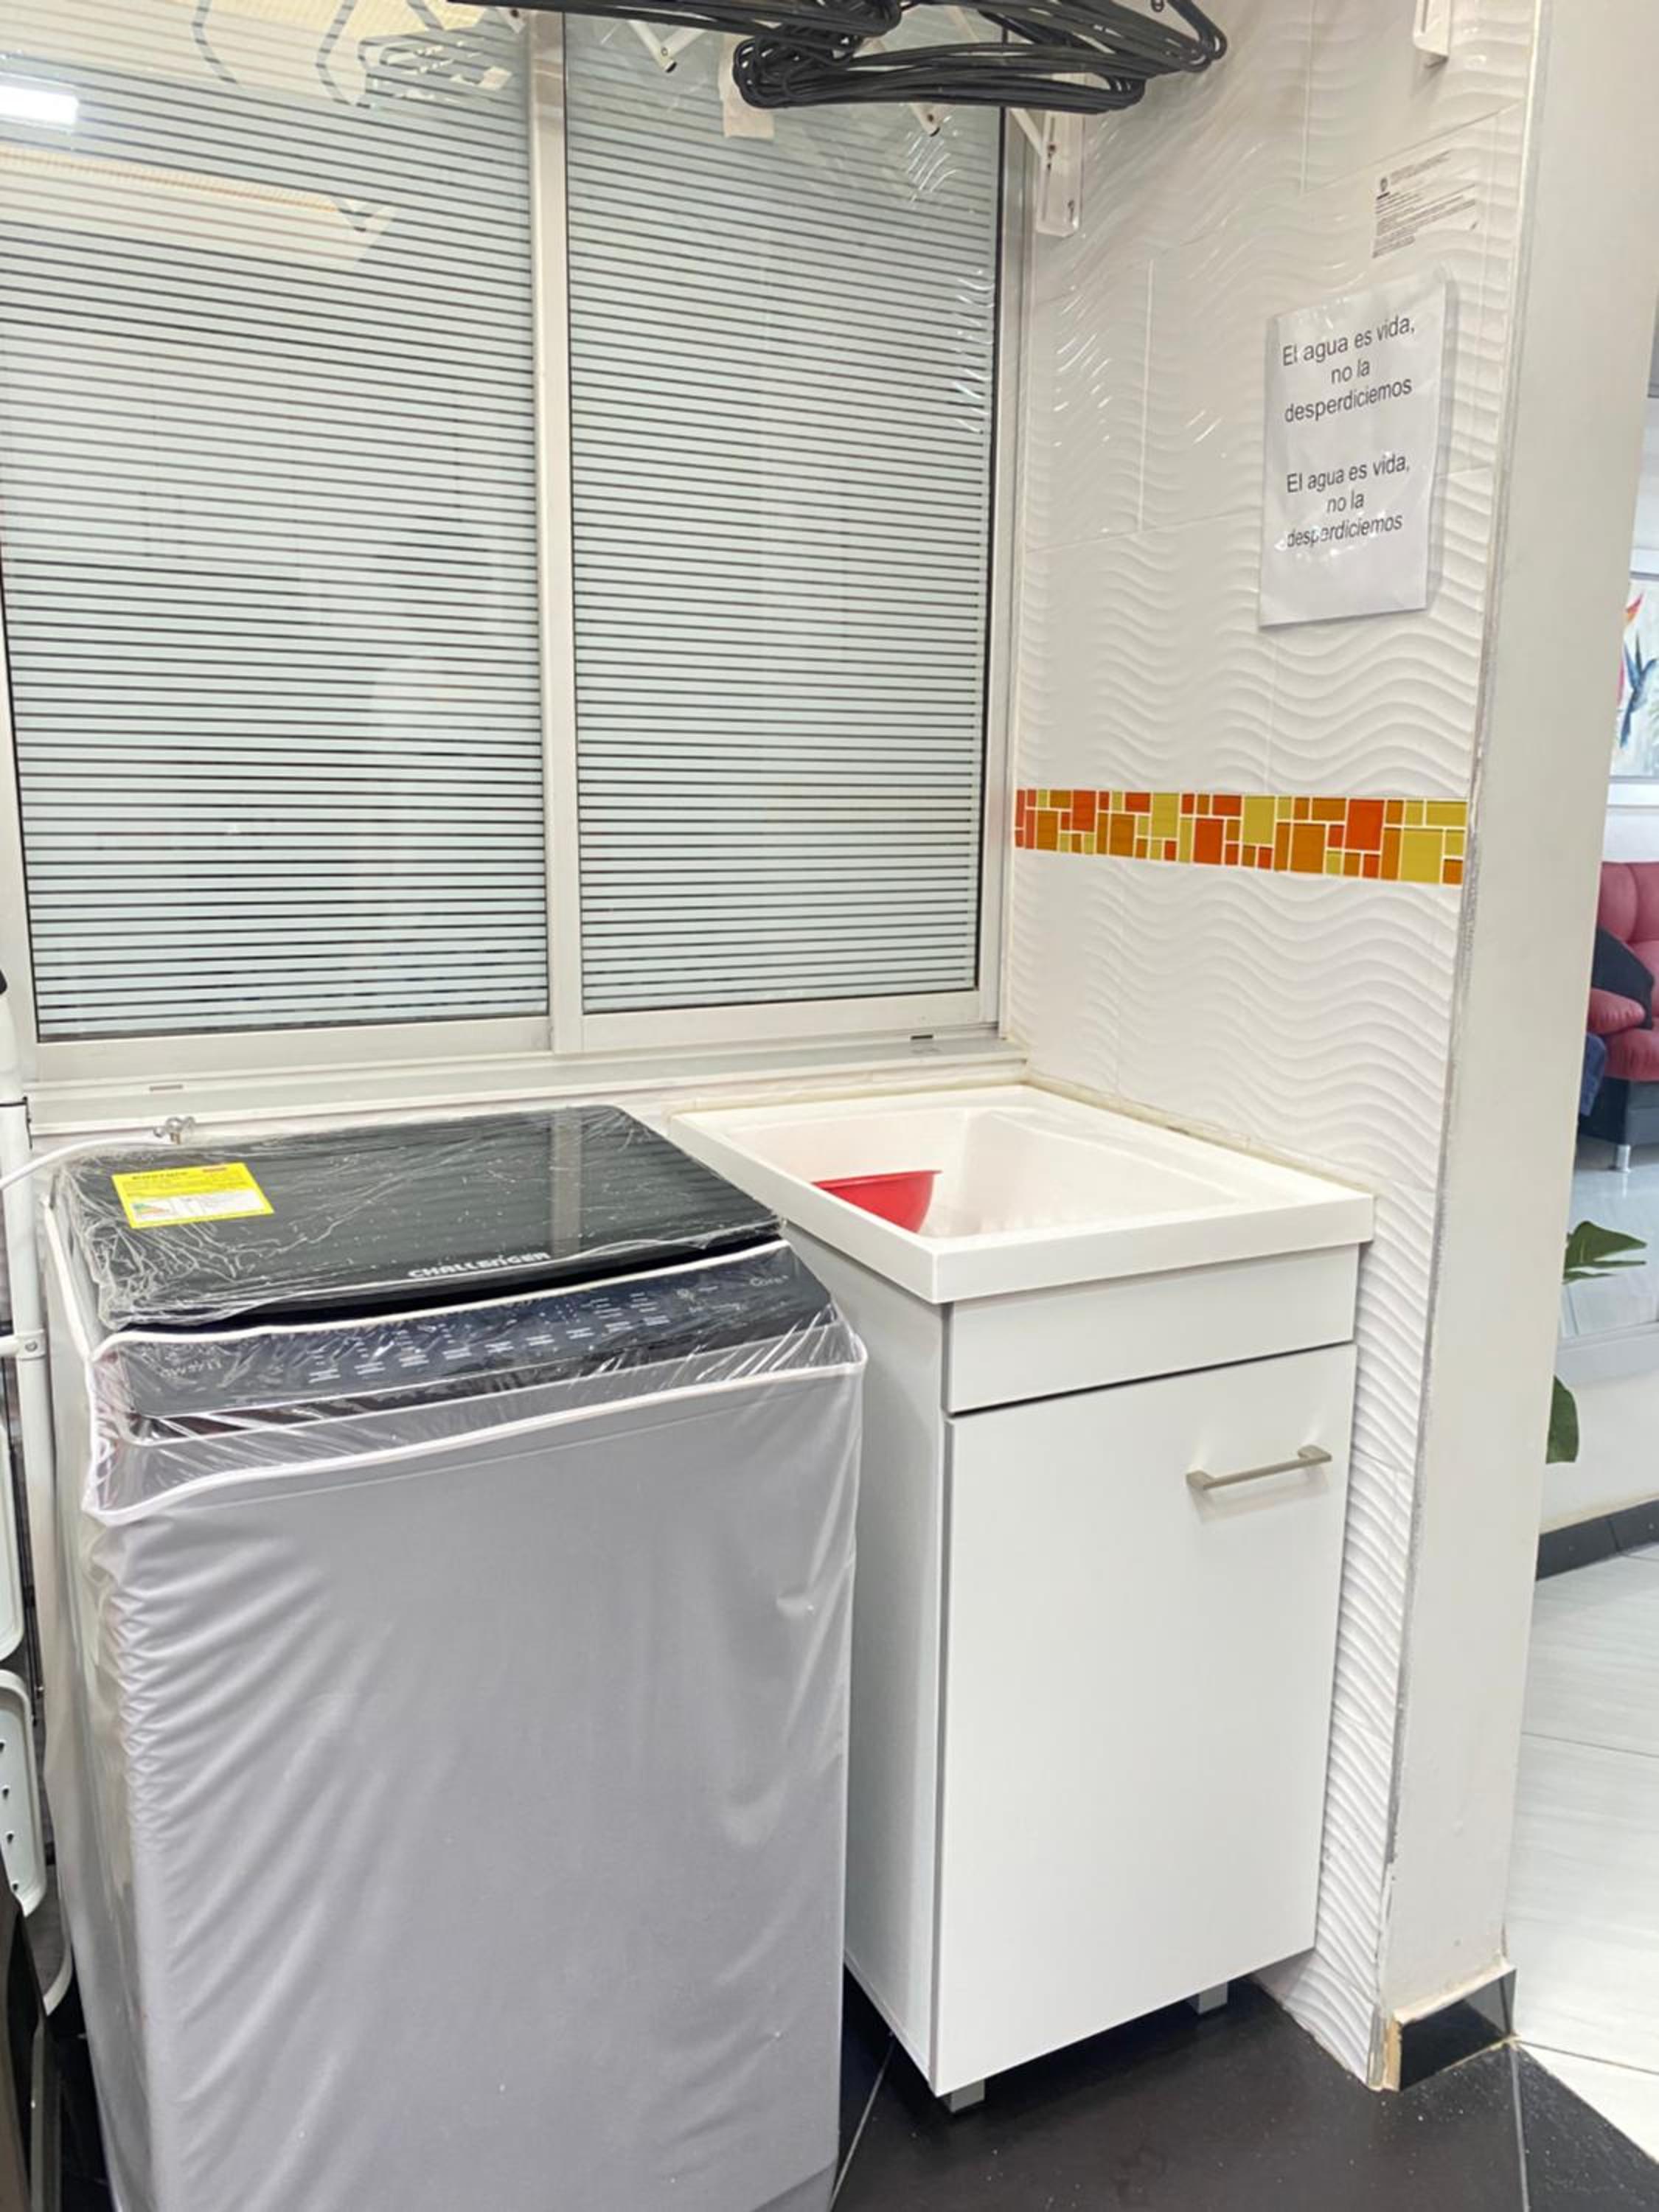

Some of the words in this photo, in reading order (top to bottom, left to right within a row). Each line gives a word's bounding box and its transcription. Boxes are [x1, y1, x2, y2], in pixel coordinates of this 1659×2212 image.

[1283, 344, 1298, 366] El
[1303, 337, 1349, 363] agua
[1354, 330, 1373, 349] es
[1377, 315, 1415, 341] vida,
[1331, 366, 1352, 384] no
[1357, 358, 1370, 378] la
[1284, 378, 1412, 422] desperdiciemos
[1287, 473, 1303, 493] El
[1307, 469, 1344, 492] agua
[1349, 464, 1367, 481] es
[1373, 454, 1410, 476] vida,
[1327, 497, 1346, 512] no
[1350, 489, 1364, 509] la
[408, 1252, 551, 1278] CHALLENGER
